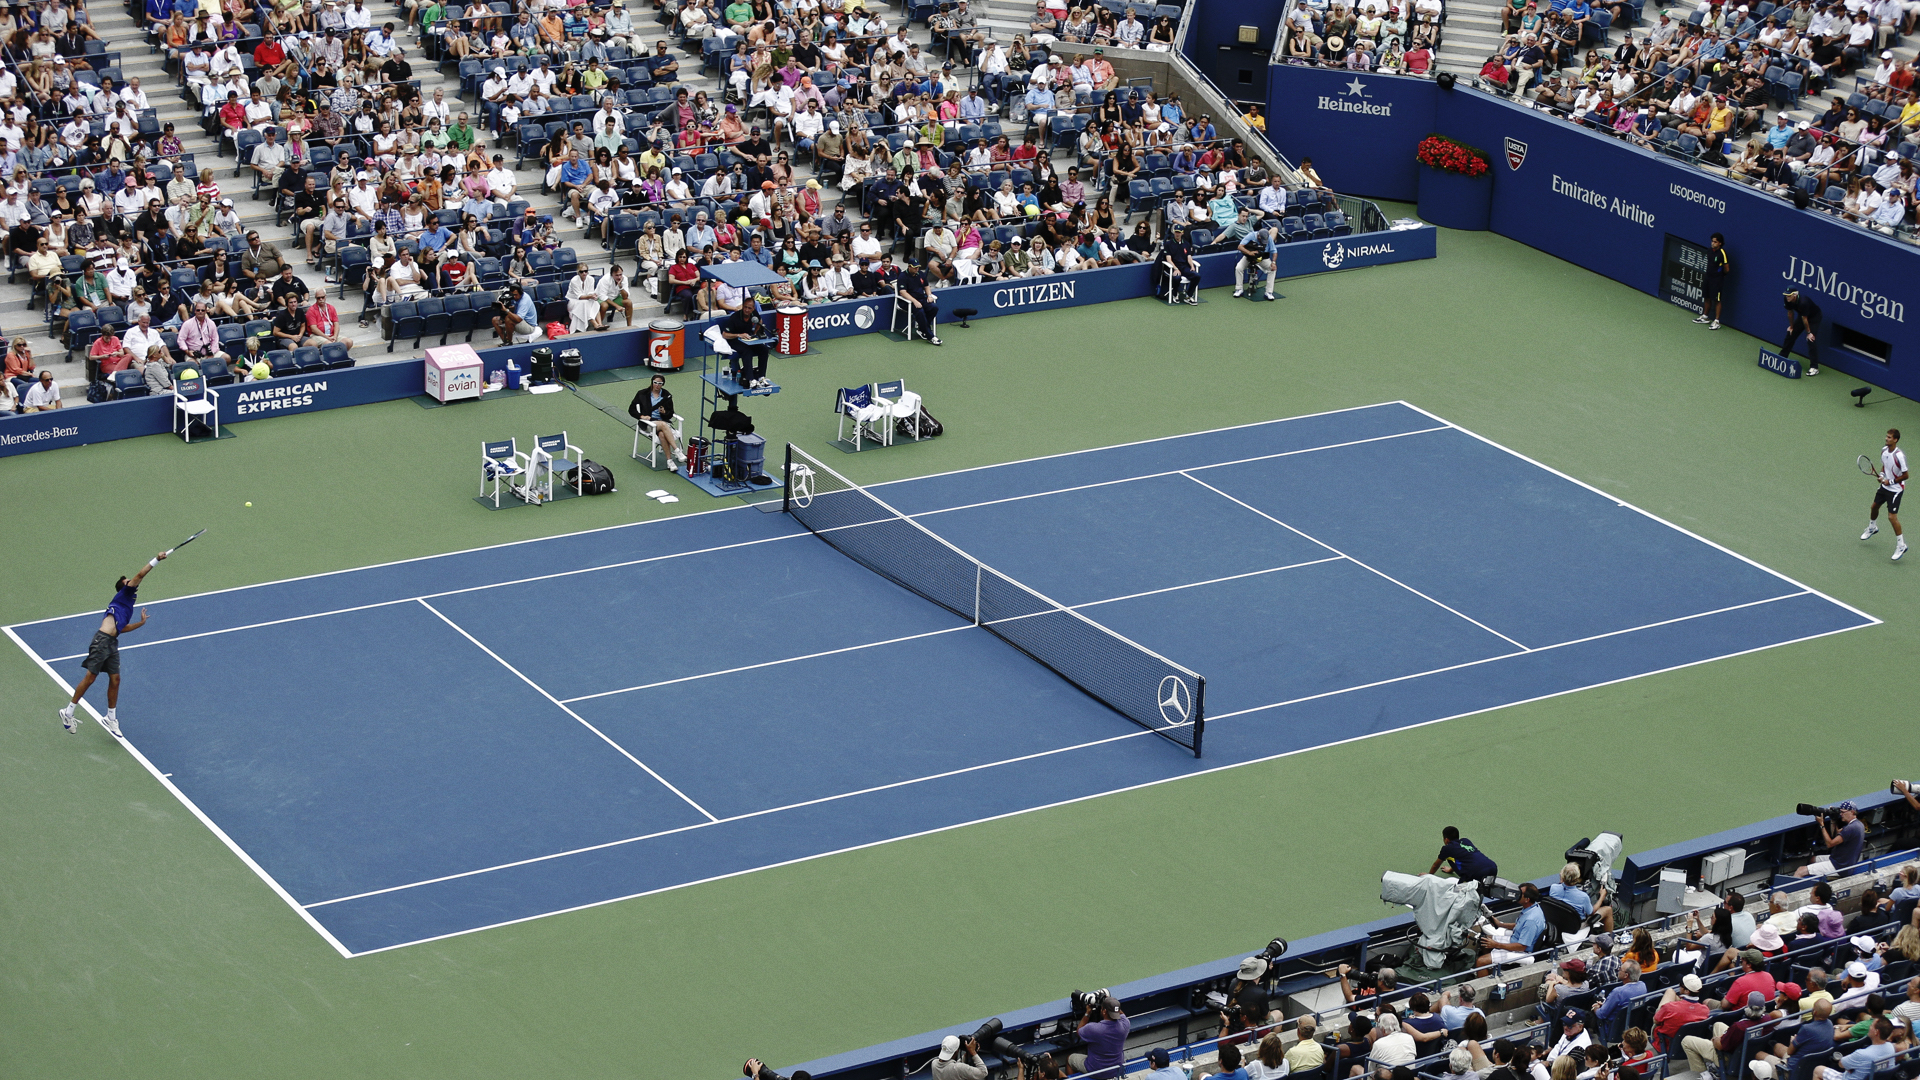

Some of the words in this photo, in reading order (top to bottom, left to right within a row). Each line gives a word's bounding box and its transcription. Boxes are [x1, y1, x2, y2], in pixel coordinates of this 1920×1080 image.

[1317, 95, 1391, 117] Heineken
[1508, 141, 1525, 154] USTA
[1552, 173, 1608, 210] Emirates
[1609, 196, 1656, 229] Airline
[1669, 182, 1726, 214] usopen.org
[1347, 242, 1395, 259] NIRMAL
[1679, 244, 1709, 273] IBM
[1680, 266, 1704, 288] 114
[993, 280, 1076, 309] CITIZEN
[1686, 284, 1705, 303] MP
[1670, 294, 1704, 315] usopen.org
[806, 312, 851, 330] xerox
[780, 316, 791, 355] Wilson
[439, 352, 475, 364] evian
[650, 339, 669, 363] G
[1761, 352, 1787, 373] POLO
[237, 381, 328, 403] AMERICAN
[447, 380, 477, 393] evian
[237, 395, 313, 415] EXPRESS
[0, 426, 79, 446] Mercedes-Benz
